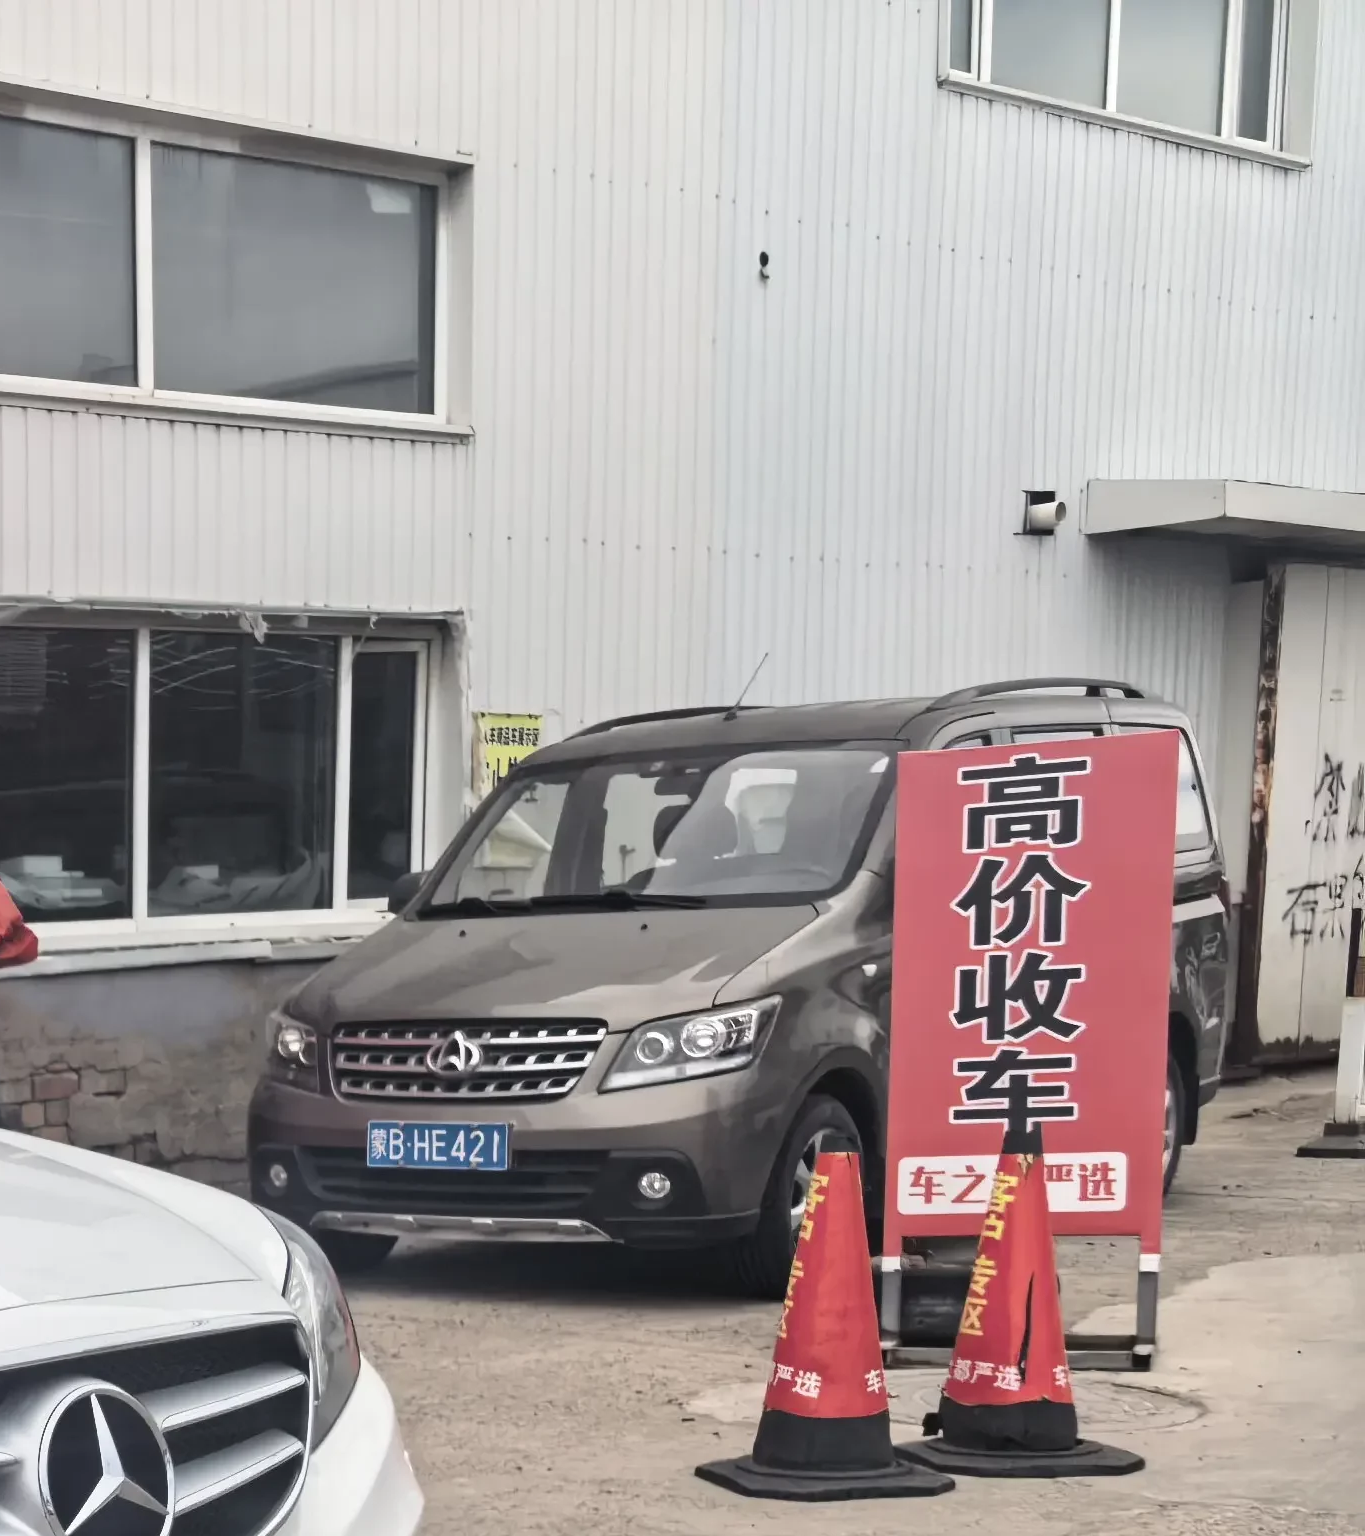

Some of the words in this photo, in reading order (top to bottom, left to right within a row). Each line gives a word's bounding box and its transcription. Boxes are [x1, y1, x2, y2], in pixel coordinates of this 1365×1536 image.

[951, 756, 1091, 1134] 高价收车
[908, 1163, 1117, 1206] 车之严选
[771, 1363, 822, 1398] 严选
[949, 1357, 1022, 1391] 都严选
